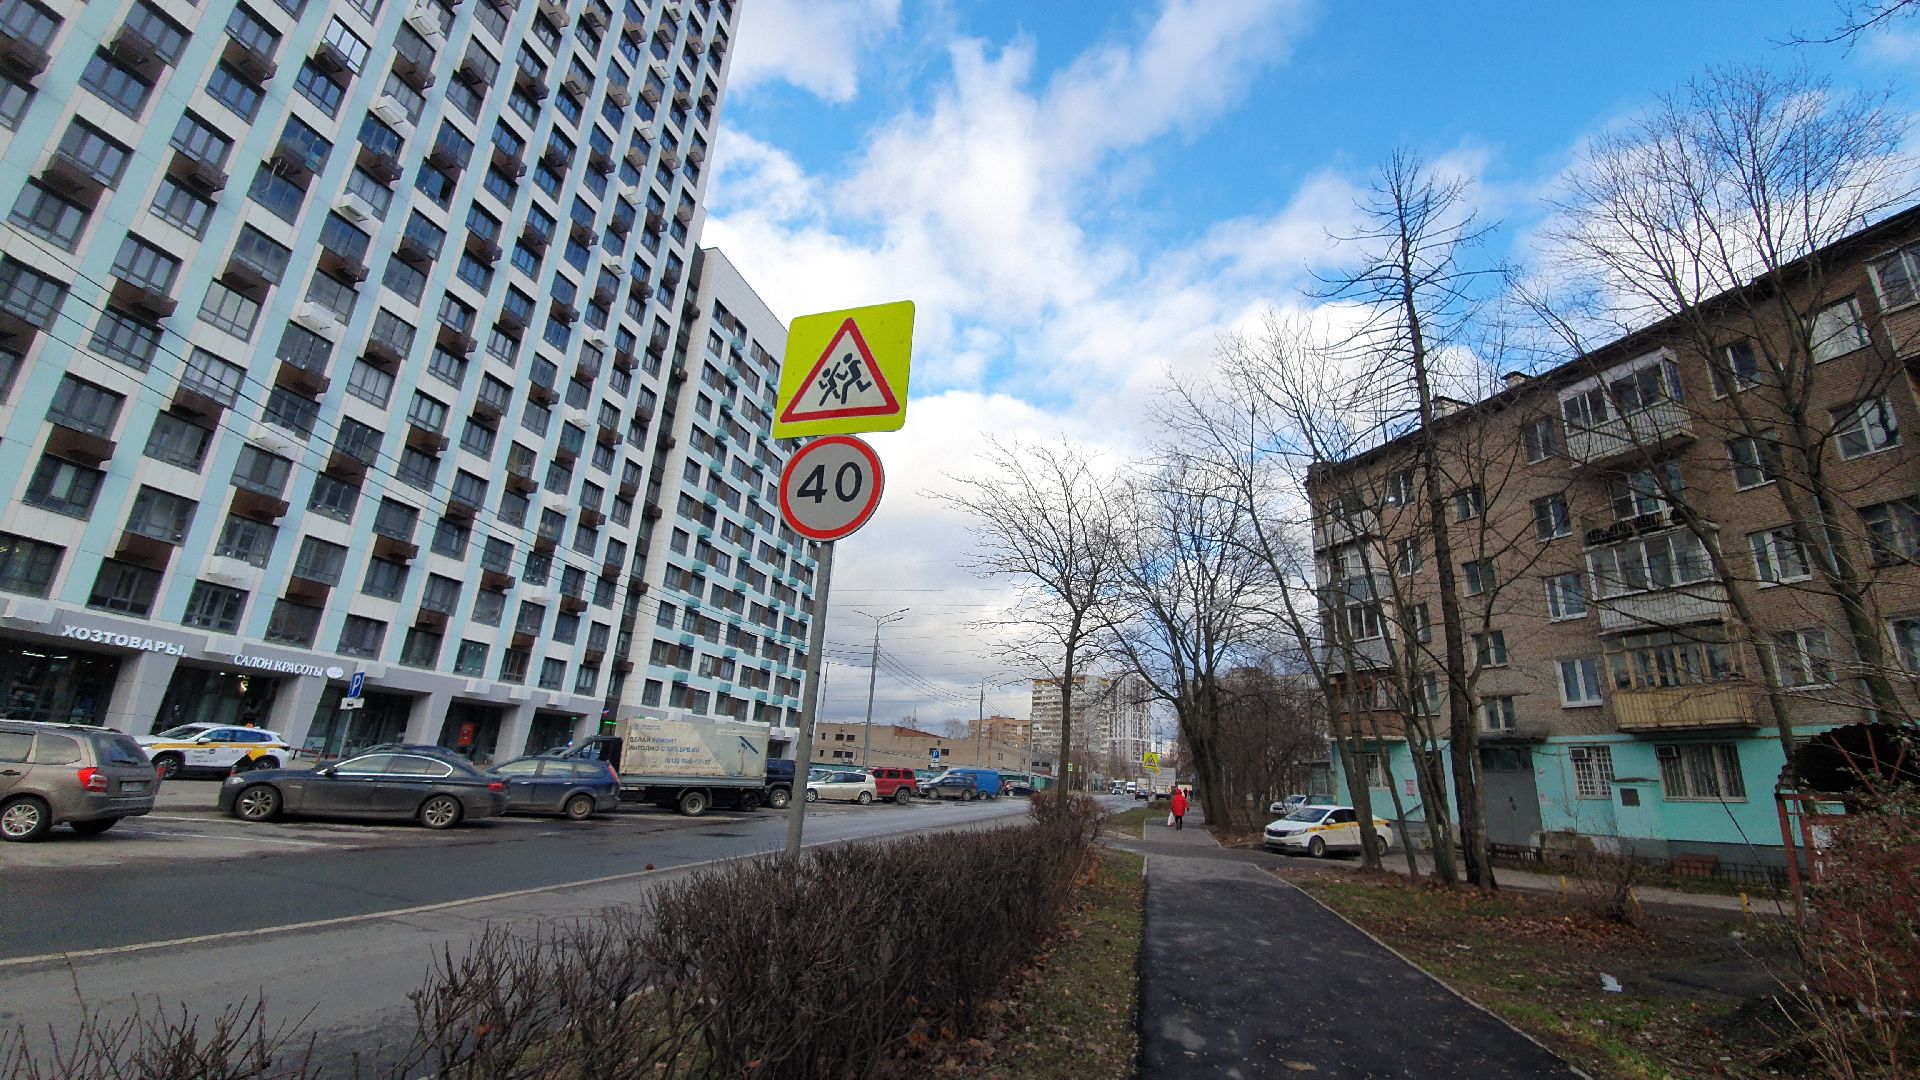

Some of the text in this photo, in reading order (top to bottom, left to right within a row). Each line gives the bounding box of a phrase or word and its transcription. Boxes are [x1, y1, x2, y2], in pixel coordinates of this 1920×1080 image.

[797, 461, 862, 504] 40
[234, 654, 274, 671] САЛОН
[273, 661, 324, 677] КРАСОТЫ
[350, 674, 362, 696] P
